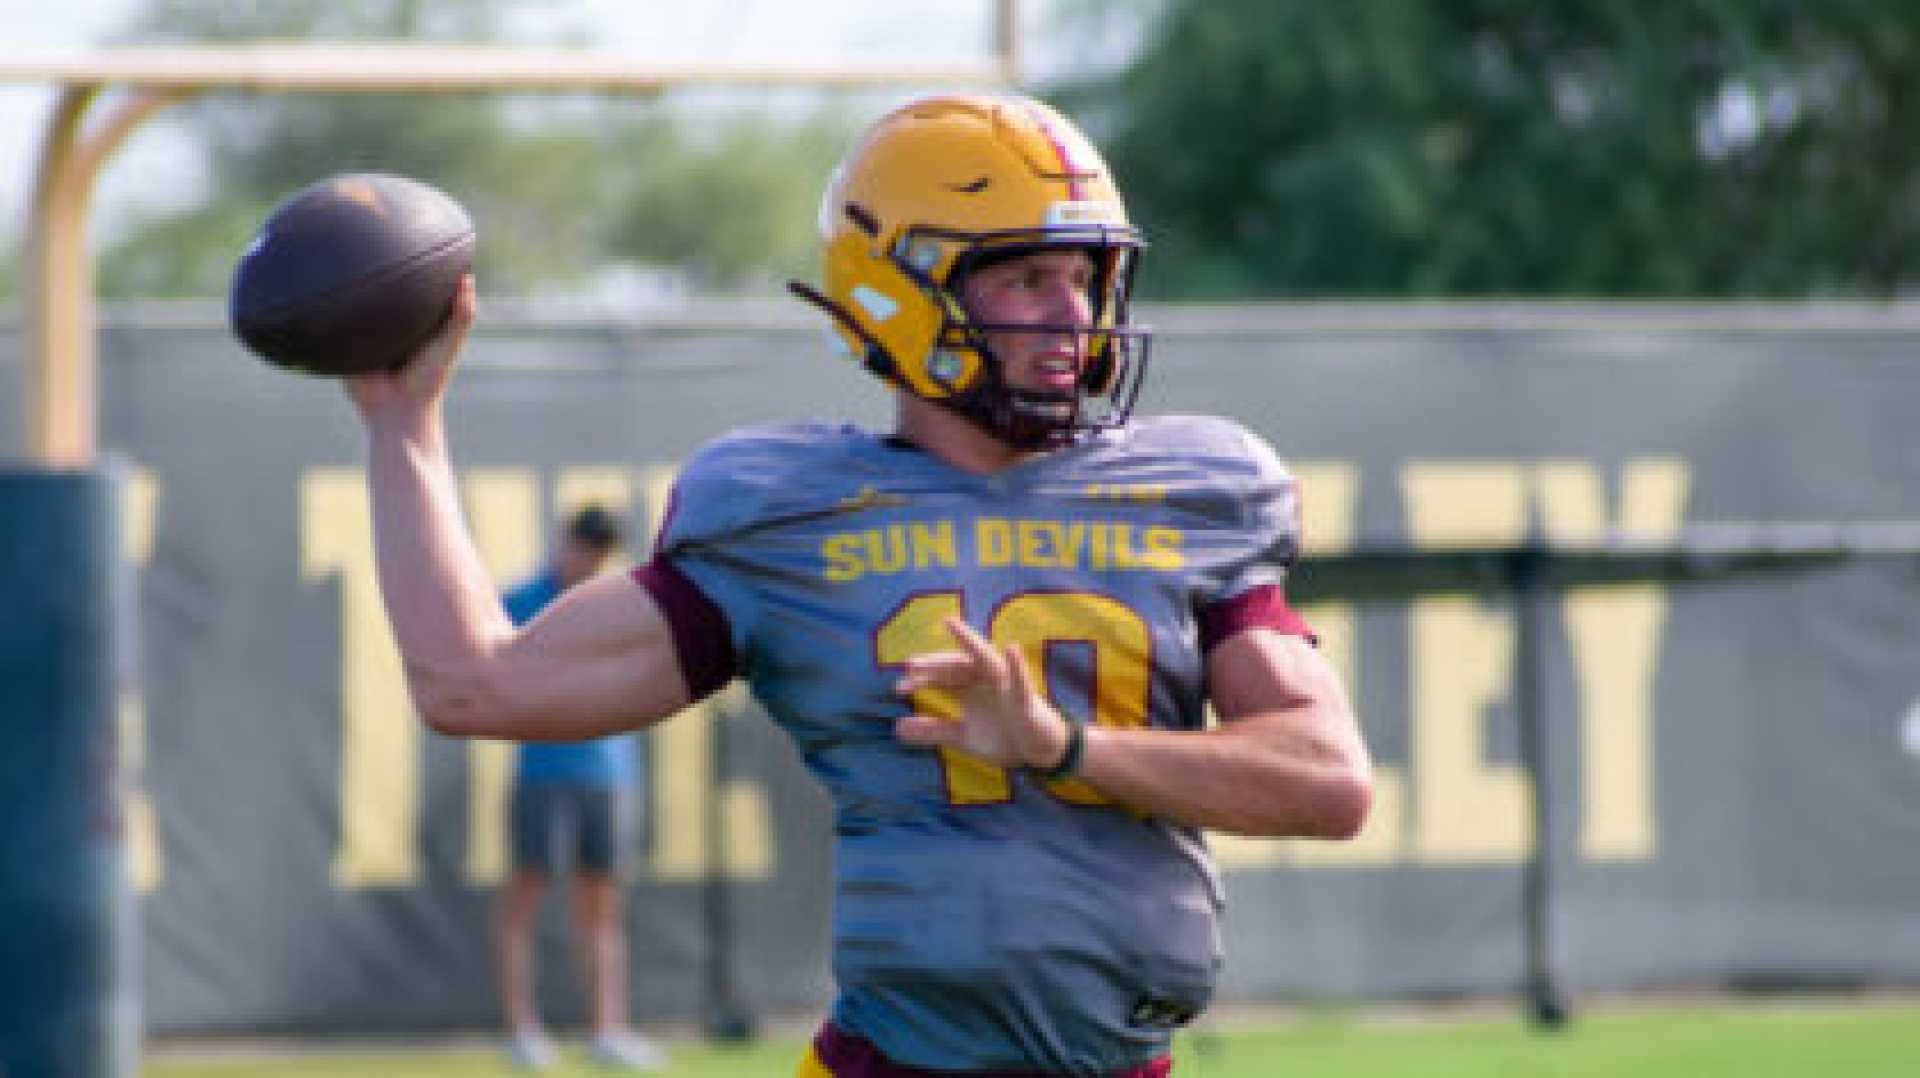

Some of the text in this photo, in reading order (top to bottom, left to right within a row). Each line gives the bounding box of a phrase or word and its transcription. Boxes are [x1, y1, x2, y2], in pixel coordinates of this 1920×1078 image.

[822, 517, 1186, 583] SUN DEVILS
[873, 588, 1154, 811] 10
